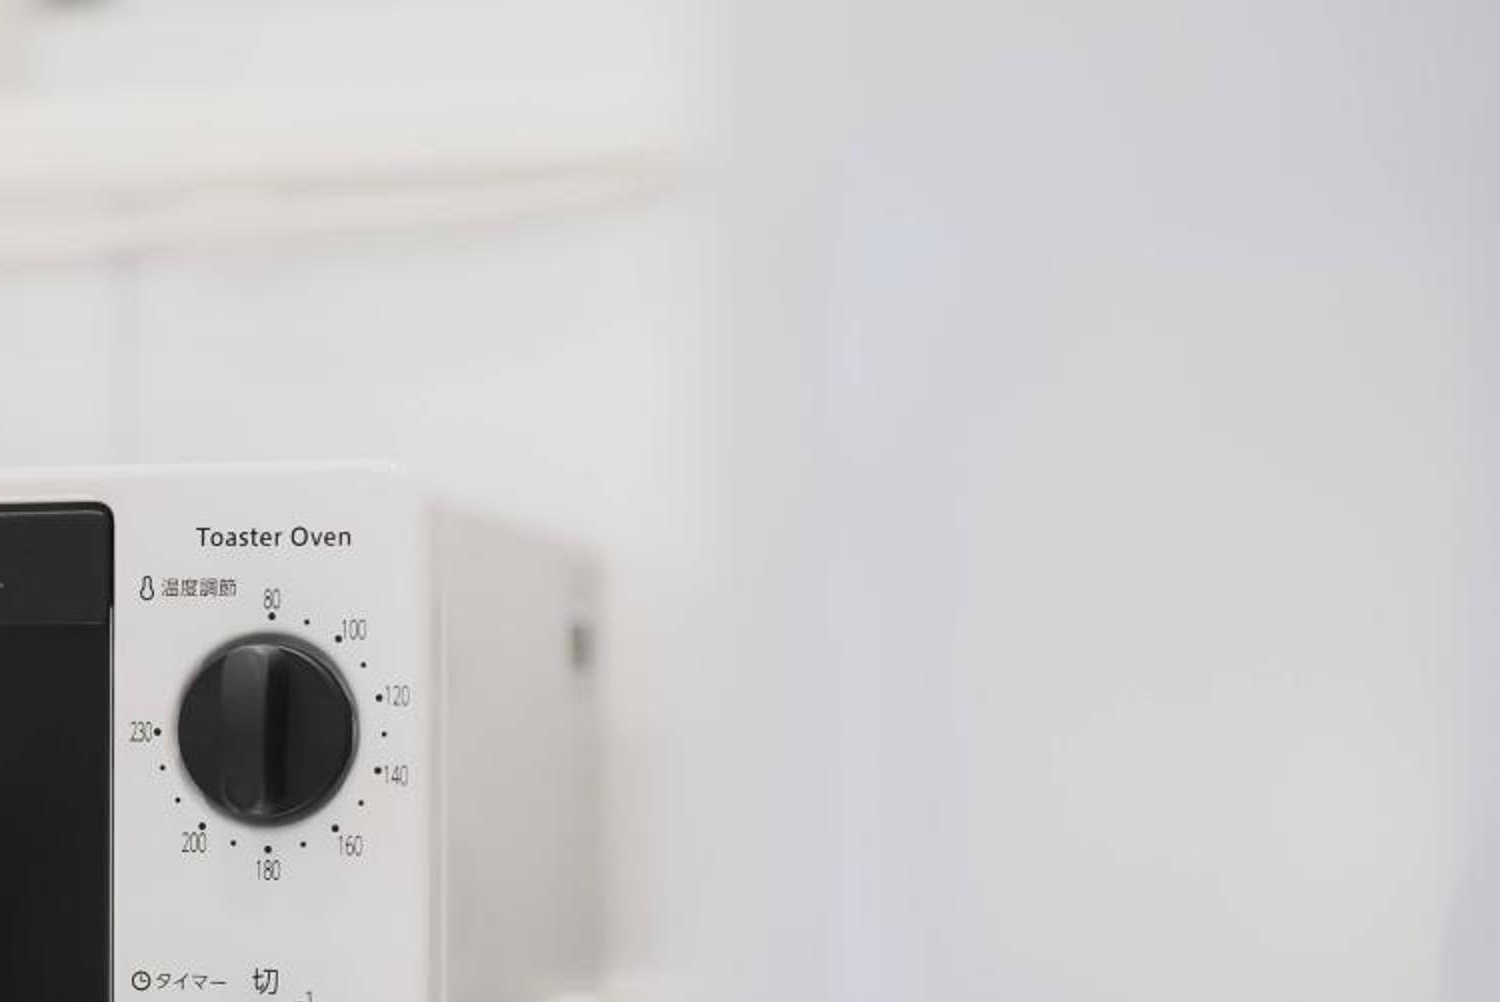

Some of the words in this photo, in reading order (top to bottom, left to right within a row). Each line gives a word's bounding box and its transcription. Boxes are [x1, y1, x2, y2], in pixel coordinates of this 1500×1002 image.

[196, 527, 282, 547] Toaster
[291, 527, 351, 547] Oven
[161, 578, 237, 597] 温度調節
[263, 589, 281, 609] 80
[342, 619, 366, 640] 100
[385, 685, 410, 707] 120
[129, 721, 152, 743] 230
[383, 765, 409, 786] 140
[181, 832, 207, 853] 200
[339, 835, 363, 856] 160
[256, 860, 281, 881] 180
[155, 972, 227, 990] タイマー
[252, 968, 279, 995] 切
